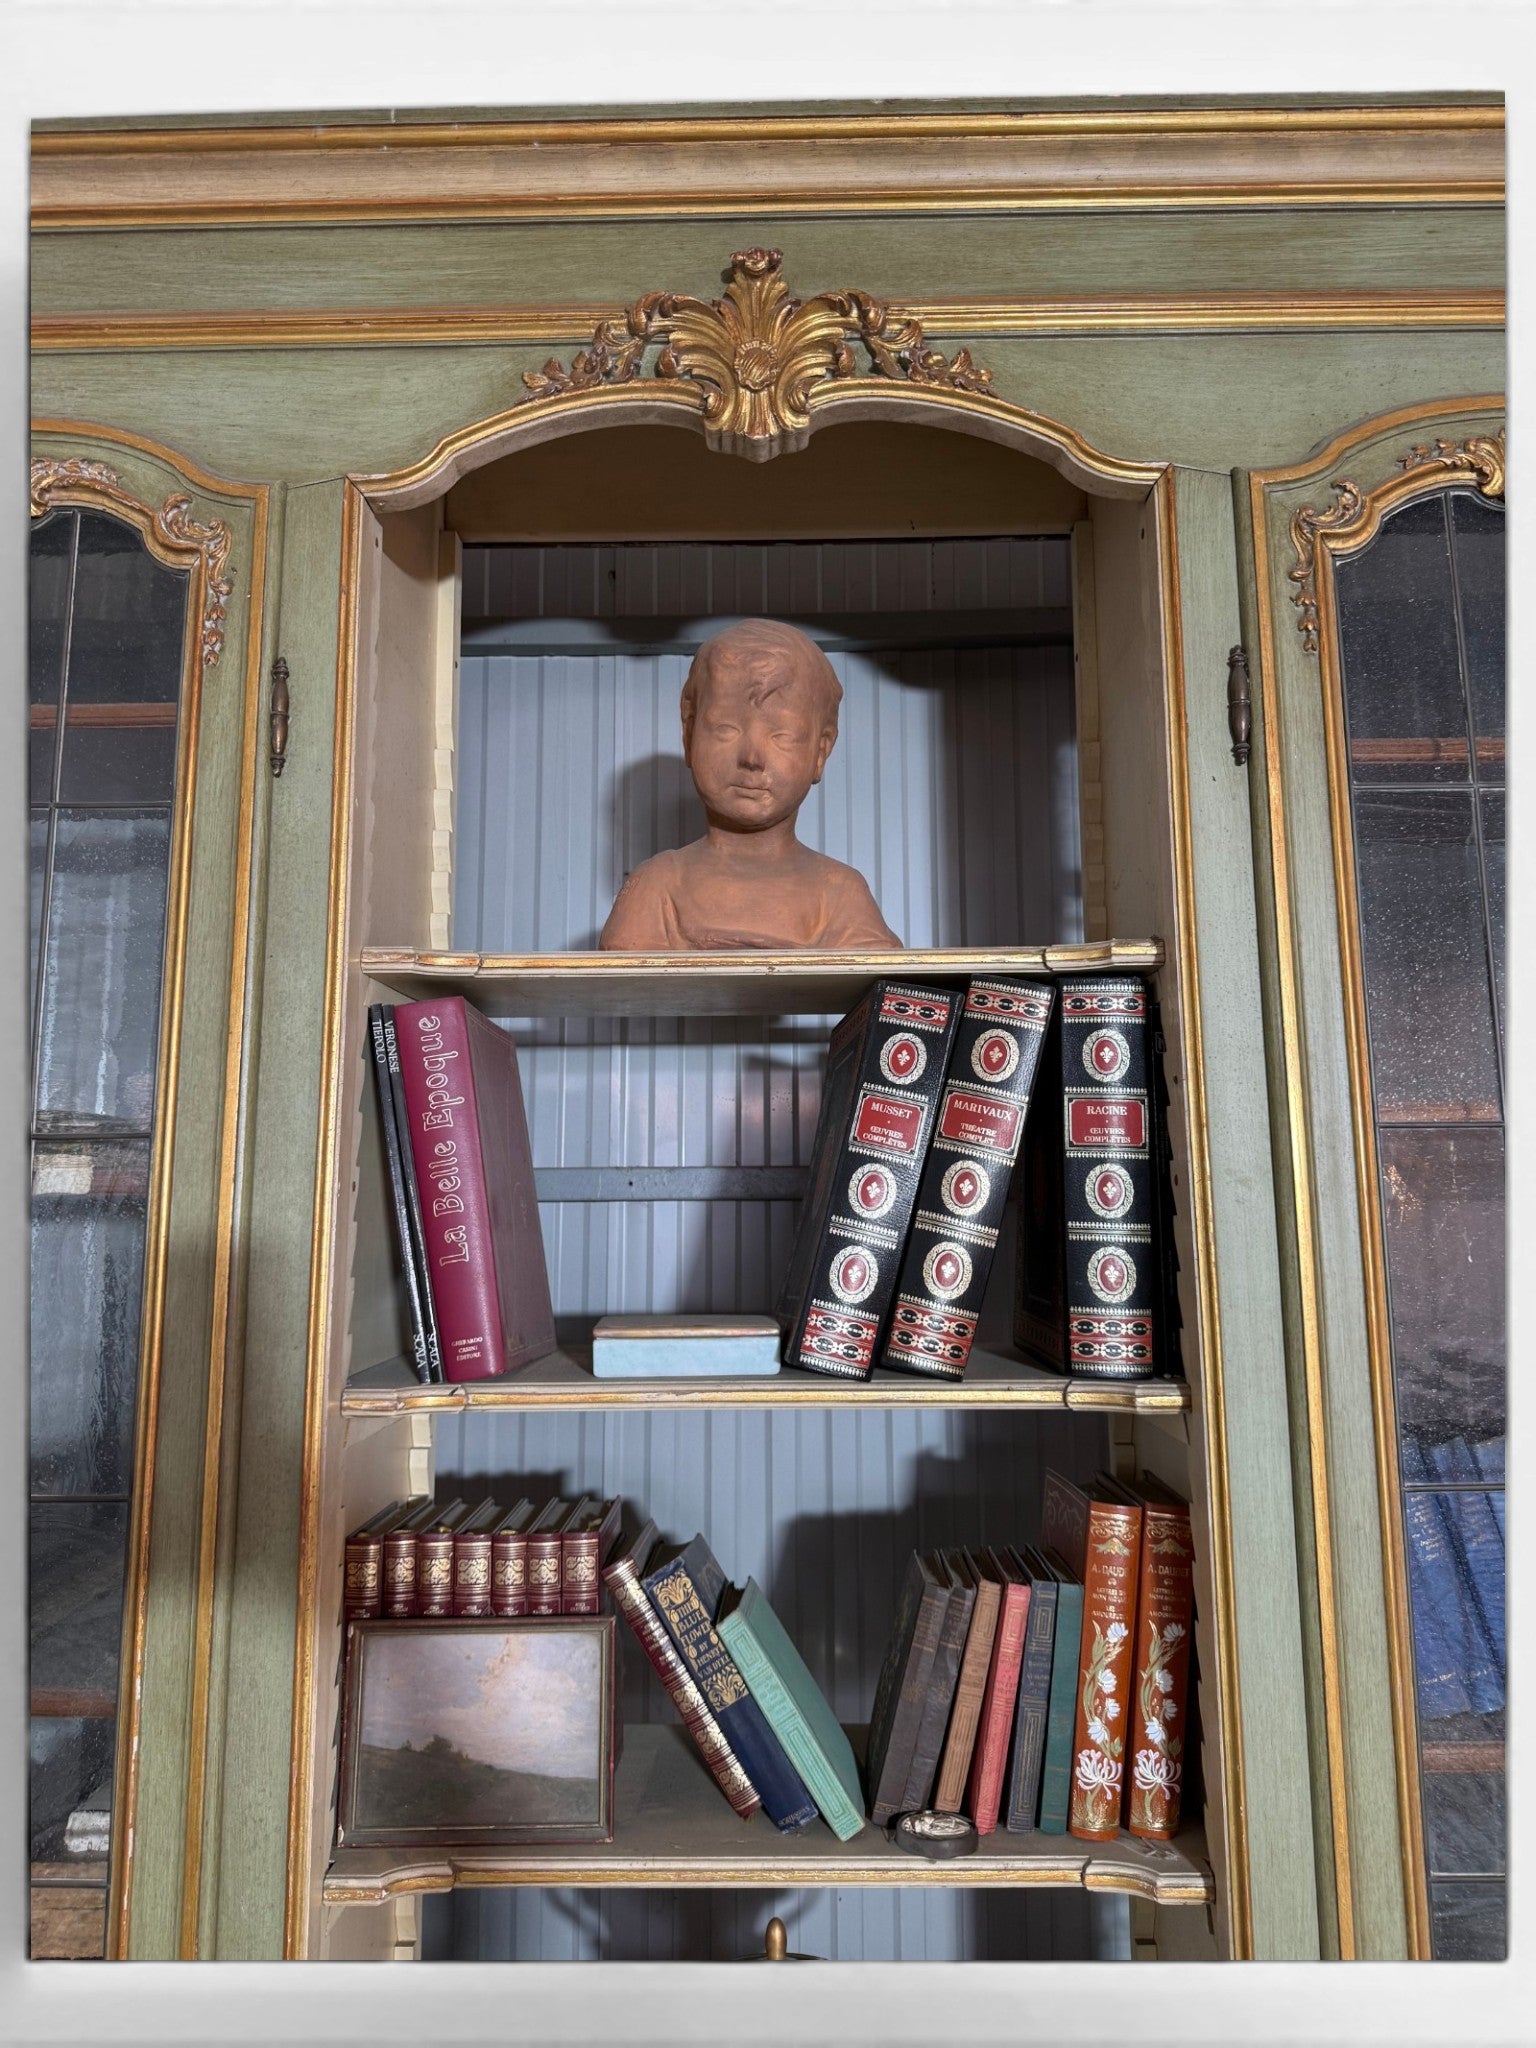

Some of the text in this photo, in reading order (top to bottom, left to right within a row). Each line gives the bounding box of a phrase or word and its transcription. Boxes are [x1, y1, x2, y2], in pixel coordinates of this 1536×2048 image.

[372, 1018, 386, 1063] TIEPOLO
[384, 1020, 399, 1073] VERONESE
[870, 1102, 912, 1119] MUSSET
[953, 1099, 1012, 1120] MARIVAUX
[1086, 1105, 1128, 1116] RACINE
[418, 1015, 469, 1266] La Belle Epoque
[958, 1131, 996, 1146] COMPLET
[413, 1333, 427, 1368] SCALA
[427, 1333, 440, 1368] SCALA
[1147, 1564, 1158, 1574] A.
[678, 1609, 705, 1633] BLUE
[680, 1619, 714, 1648] FLOWER
[696, 1646, 721, 1667] HENRY
[699, 1641, 709, 1653] BY
